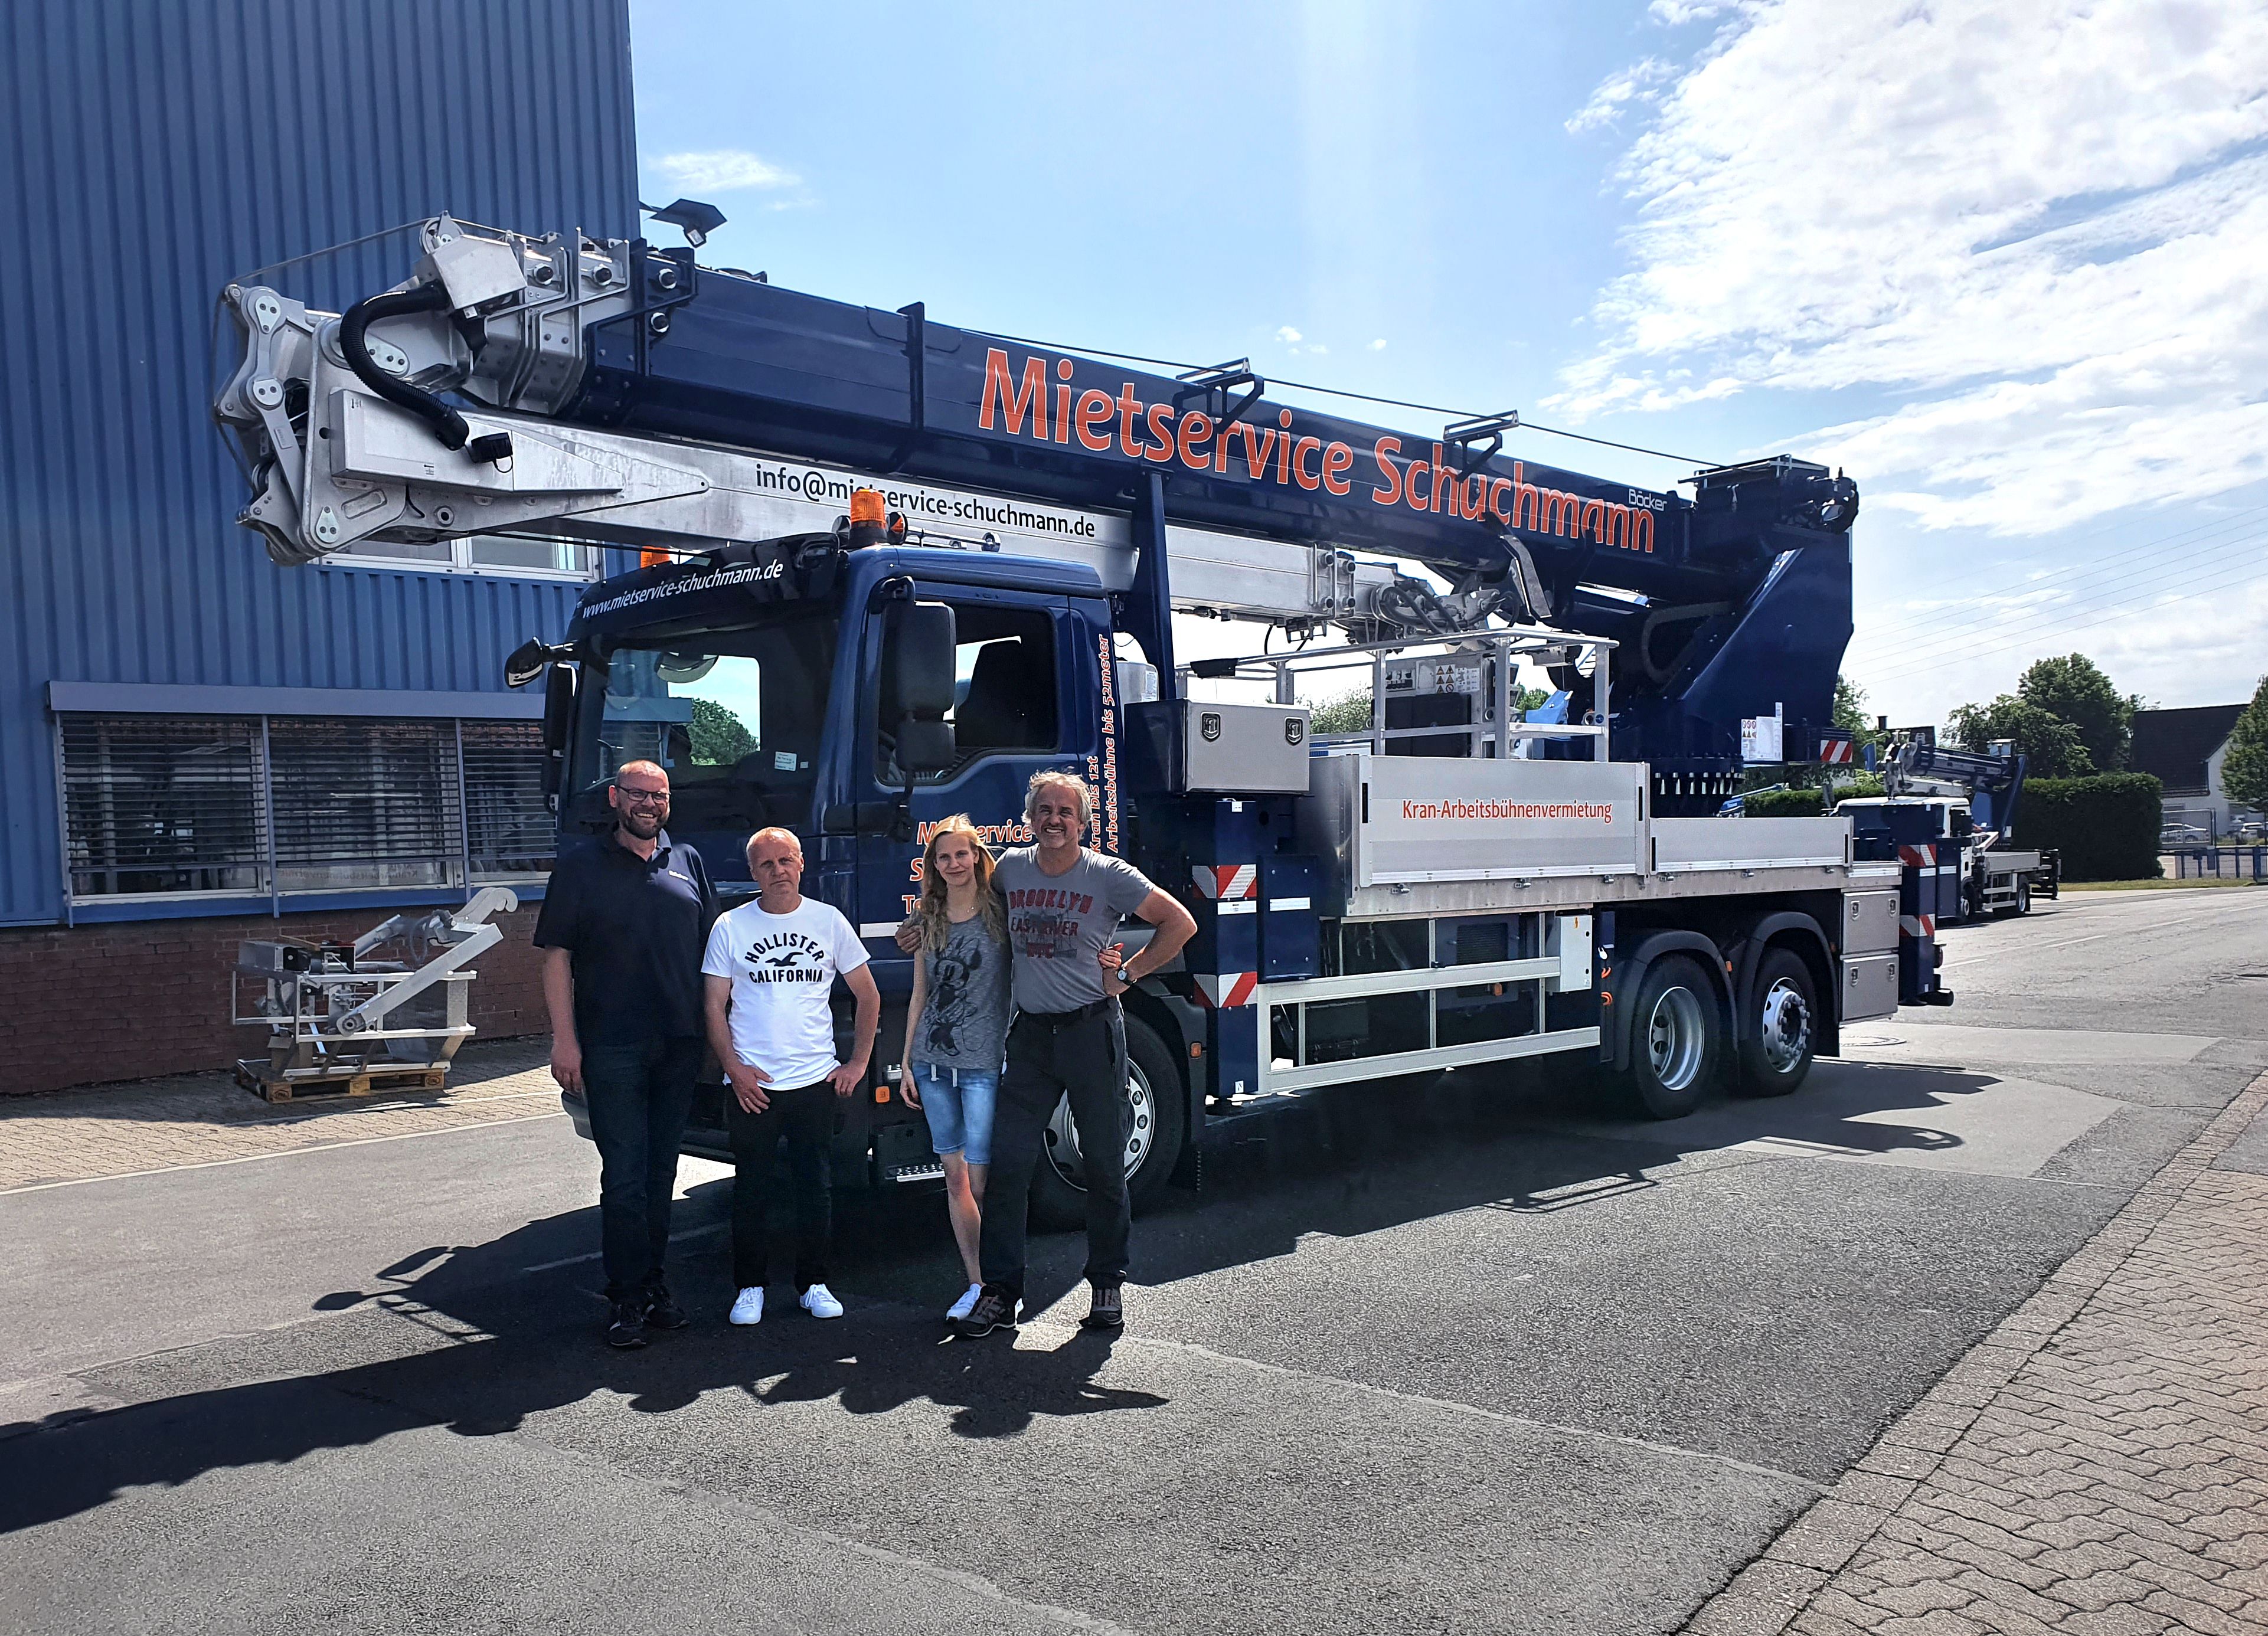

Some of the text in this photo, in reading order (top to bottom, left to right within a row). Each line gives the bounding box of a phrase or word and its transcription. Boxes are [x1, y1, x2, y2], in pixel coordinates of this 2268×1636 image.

[978, 347, 1655, 554] Mietservice Schuchmann
[756, 464, 1095, 538] info@miervice-schuchmann.de
[1629, 488, 1667, 512] Böcker
[583, 559, 783, 619] www.mietservice-schuchmann.de
[1099, 633, 1119, 853] Arbeitsbühne bis 52meter
[1086, 755, 1101, 853] Kran bis 12t
[1402, 799, 1613, 824] Kran-Arbeitsbühnenvermietung
[1009, 889, 1093, 914] BROOKLYN
[744, 932, 825, 964] HOLLISTER
[749, 968, 822, 983] CALIFORNIA
